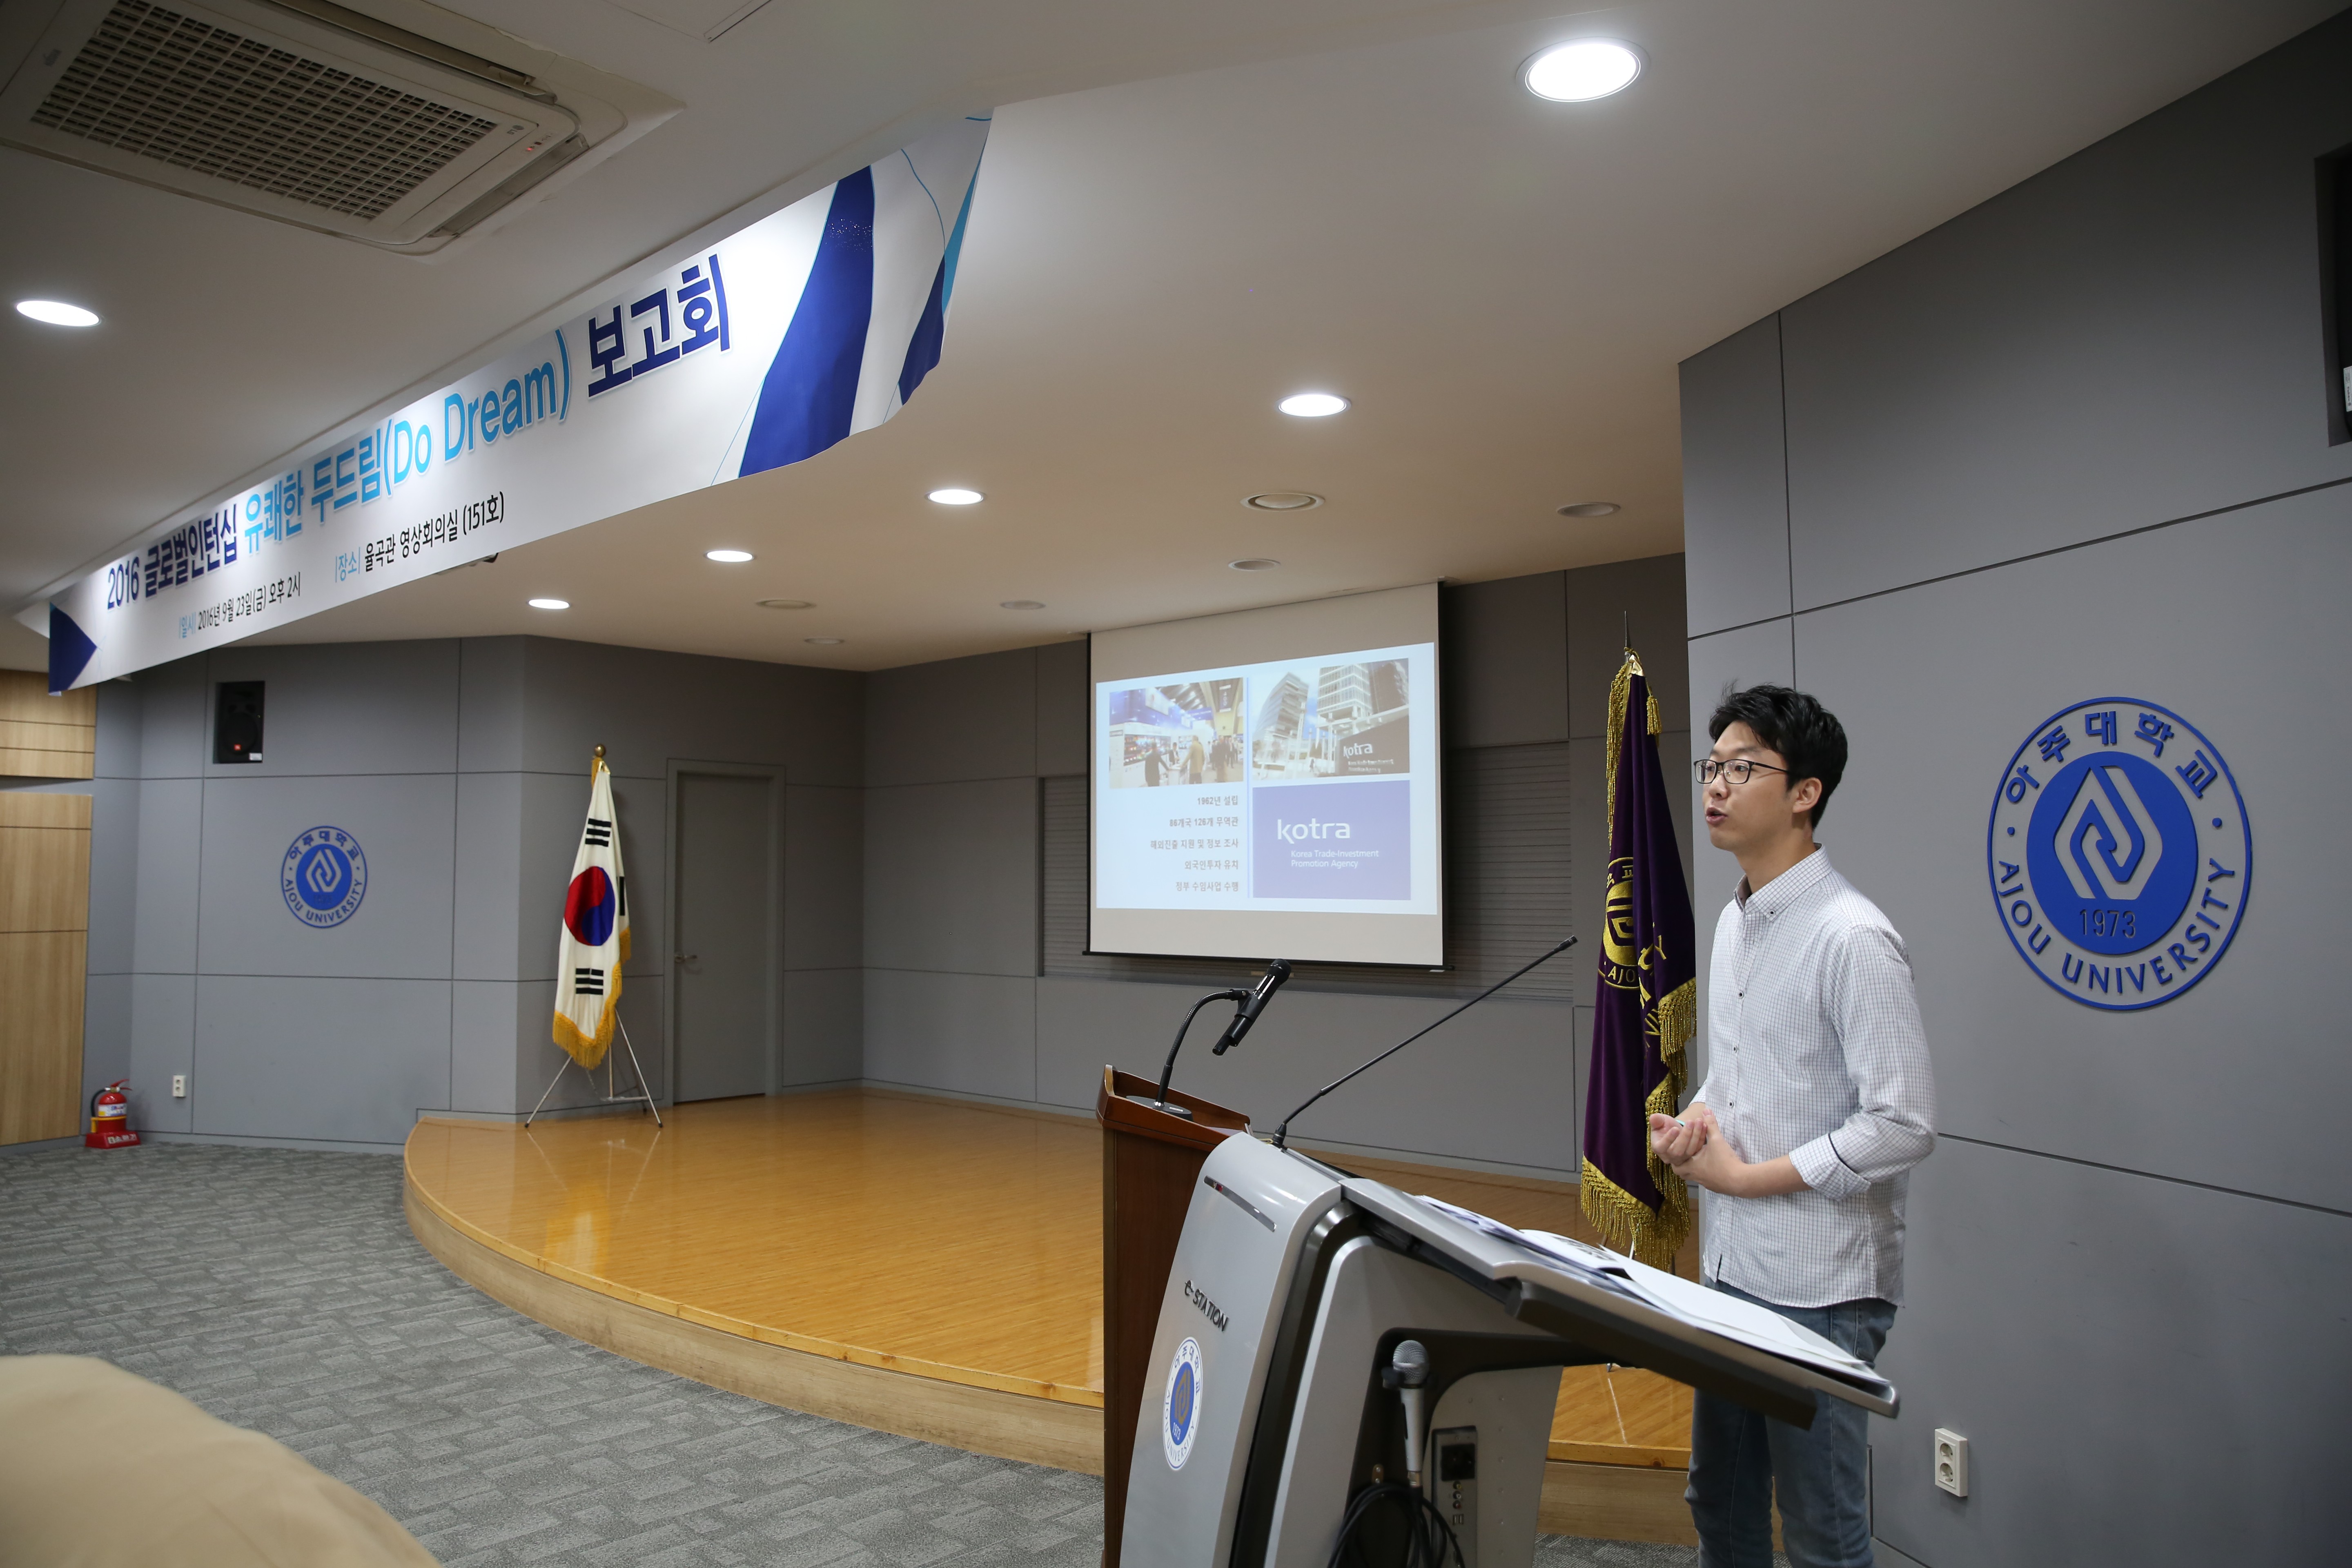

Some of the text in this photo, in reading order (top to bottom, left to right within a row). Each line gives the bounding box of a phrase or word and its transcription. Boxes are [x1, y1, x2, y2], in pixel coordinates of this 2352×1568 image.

[107, 557, 139, 609] 2016
[145, 503, 237, 598] 글로벌인턴십
[245, 470, 304, 554] 유쾌한
[445, 329, 570, 462] Dream)
[588, 254, 730, 397] 보고회
[365, 534, 395, 572] 율곡관
[400, 509, 457, 558] 영상회의실
[463, 491, 504, 535] (151호)
[198, 603, 220, 630] 2016년
[223, 598, 234, 622] 9월
[236, 586, 266, 617] 23일(금)
[269, 578, 284, 604] 오후
[287, 572, 301, 598] 2시
[1343, 743, 1373, 759] kotra
[2005, 711, 2218, 802] 아주대학교
[1197, 795, 1238, 806] 1962년 설립
[1194, 817, 1214, 827] 126개
[1216, 817, 1238, 827] 무역관
[1277, 818, 1350, 844] kotra
[289, 831, 360, 861] 아주대학교
[1150, 838, 1238, 850] 해외진출 지원 및 정보 조사
[1185, 860, 1238, 870] 외국인투자 유치
[1331, 860, 1358, 869] Agency
[1176, 882, 1189, 891] 정부
[1224, 882, 1238, 892] 수행
[285, 879, 363, 923] AJOU UNIVERSITY
[1998, 858, 2235, 993] AJOU UNIVERSITY
[2080, 909, 2136, 938] 1973
[1166, 1421, 1194, 1462] UNIVERSITY
[1172, 1422, 1181, 1441] 1973
